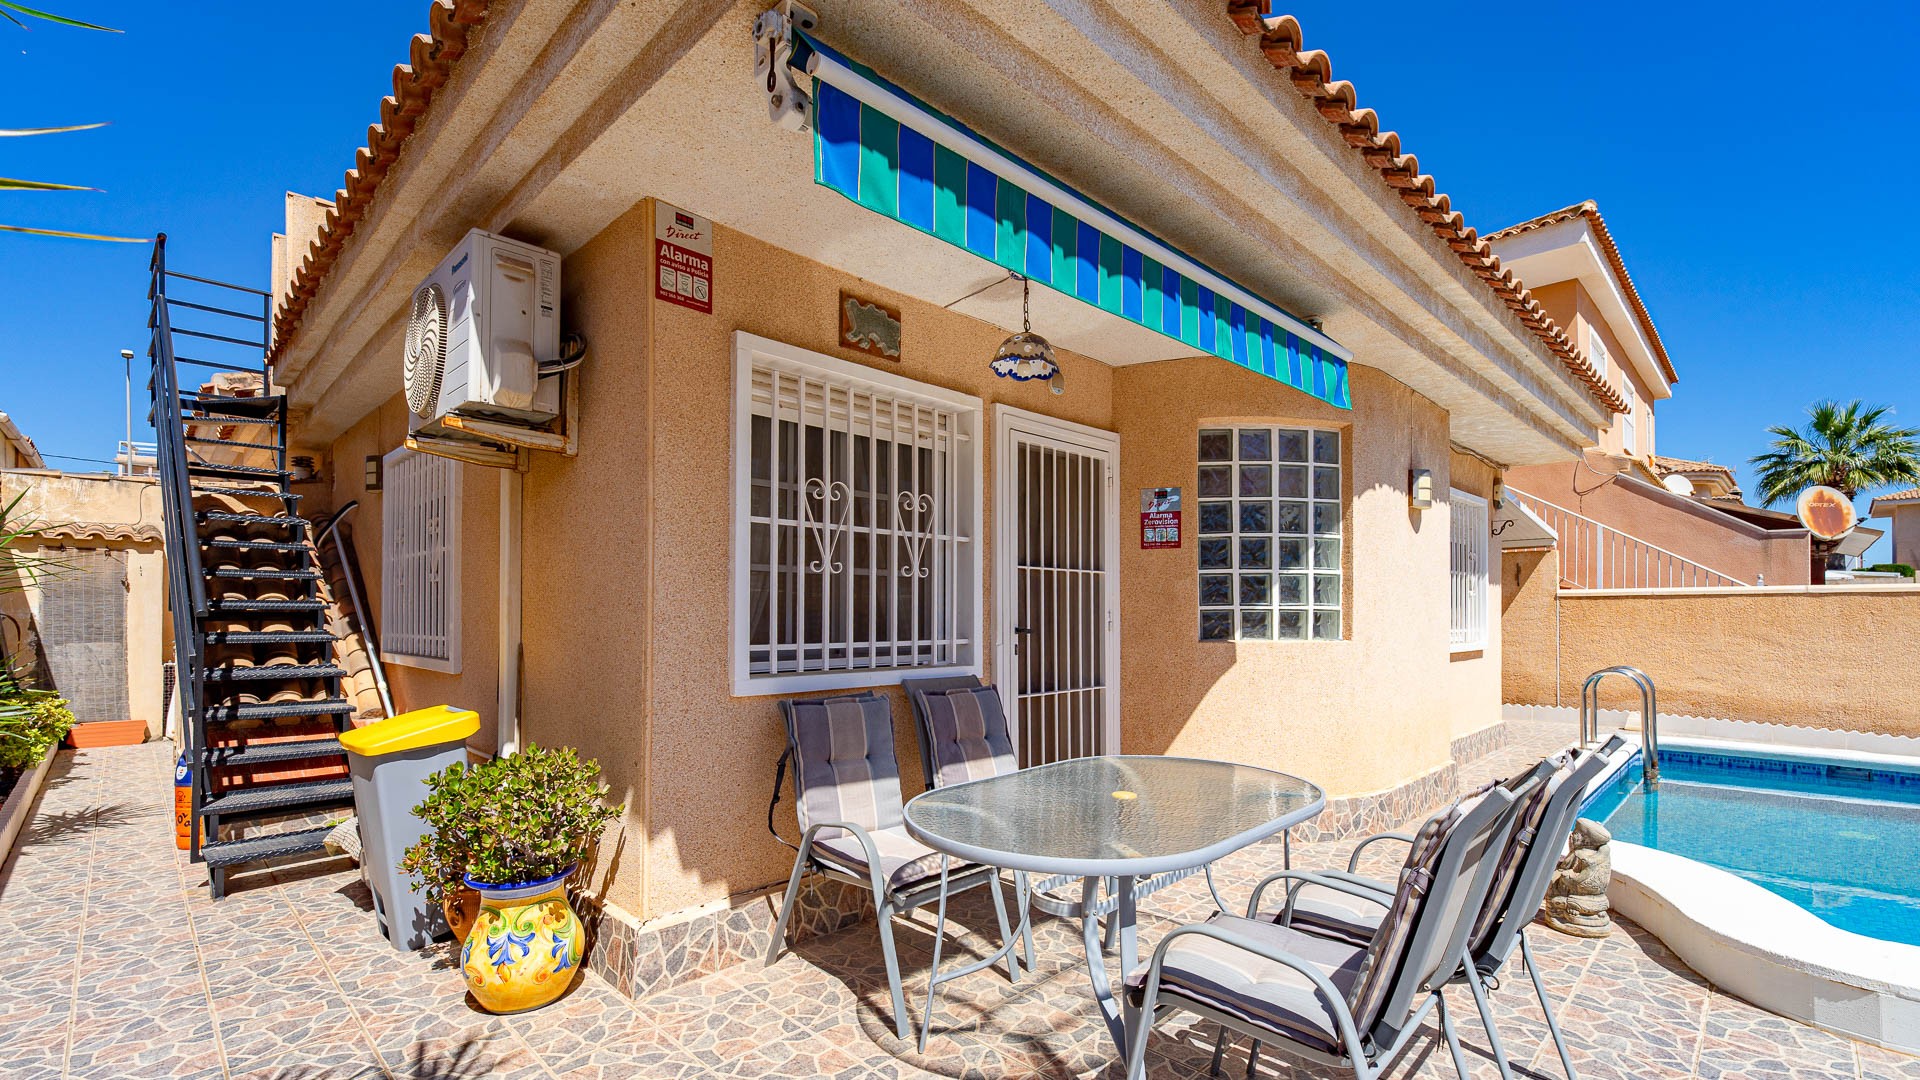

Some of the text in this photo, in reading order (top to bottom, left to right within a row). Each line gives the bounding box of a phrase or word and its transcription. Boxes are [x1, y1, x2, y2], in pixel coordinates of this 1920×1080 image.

[666, 225, 704, 240] Direct
[660, 244, 709, 272] Alarma
[660, 258, 671, 266] con
